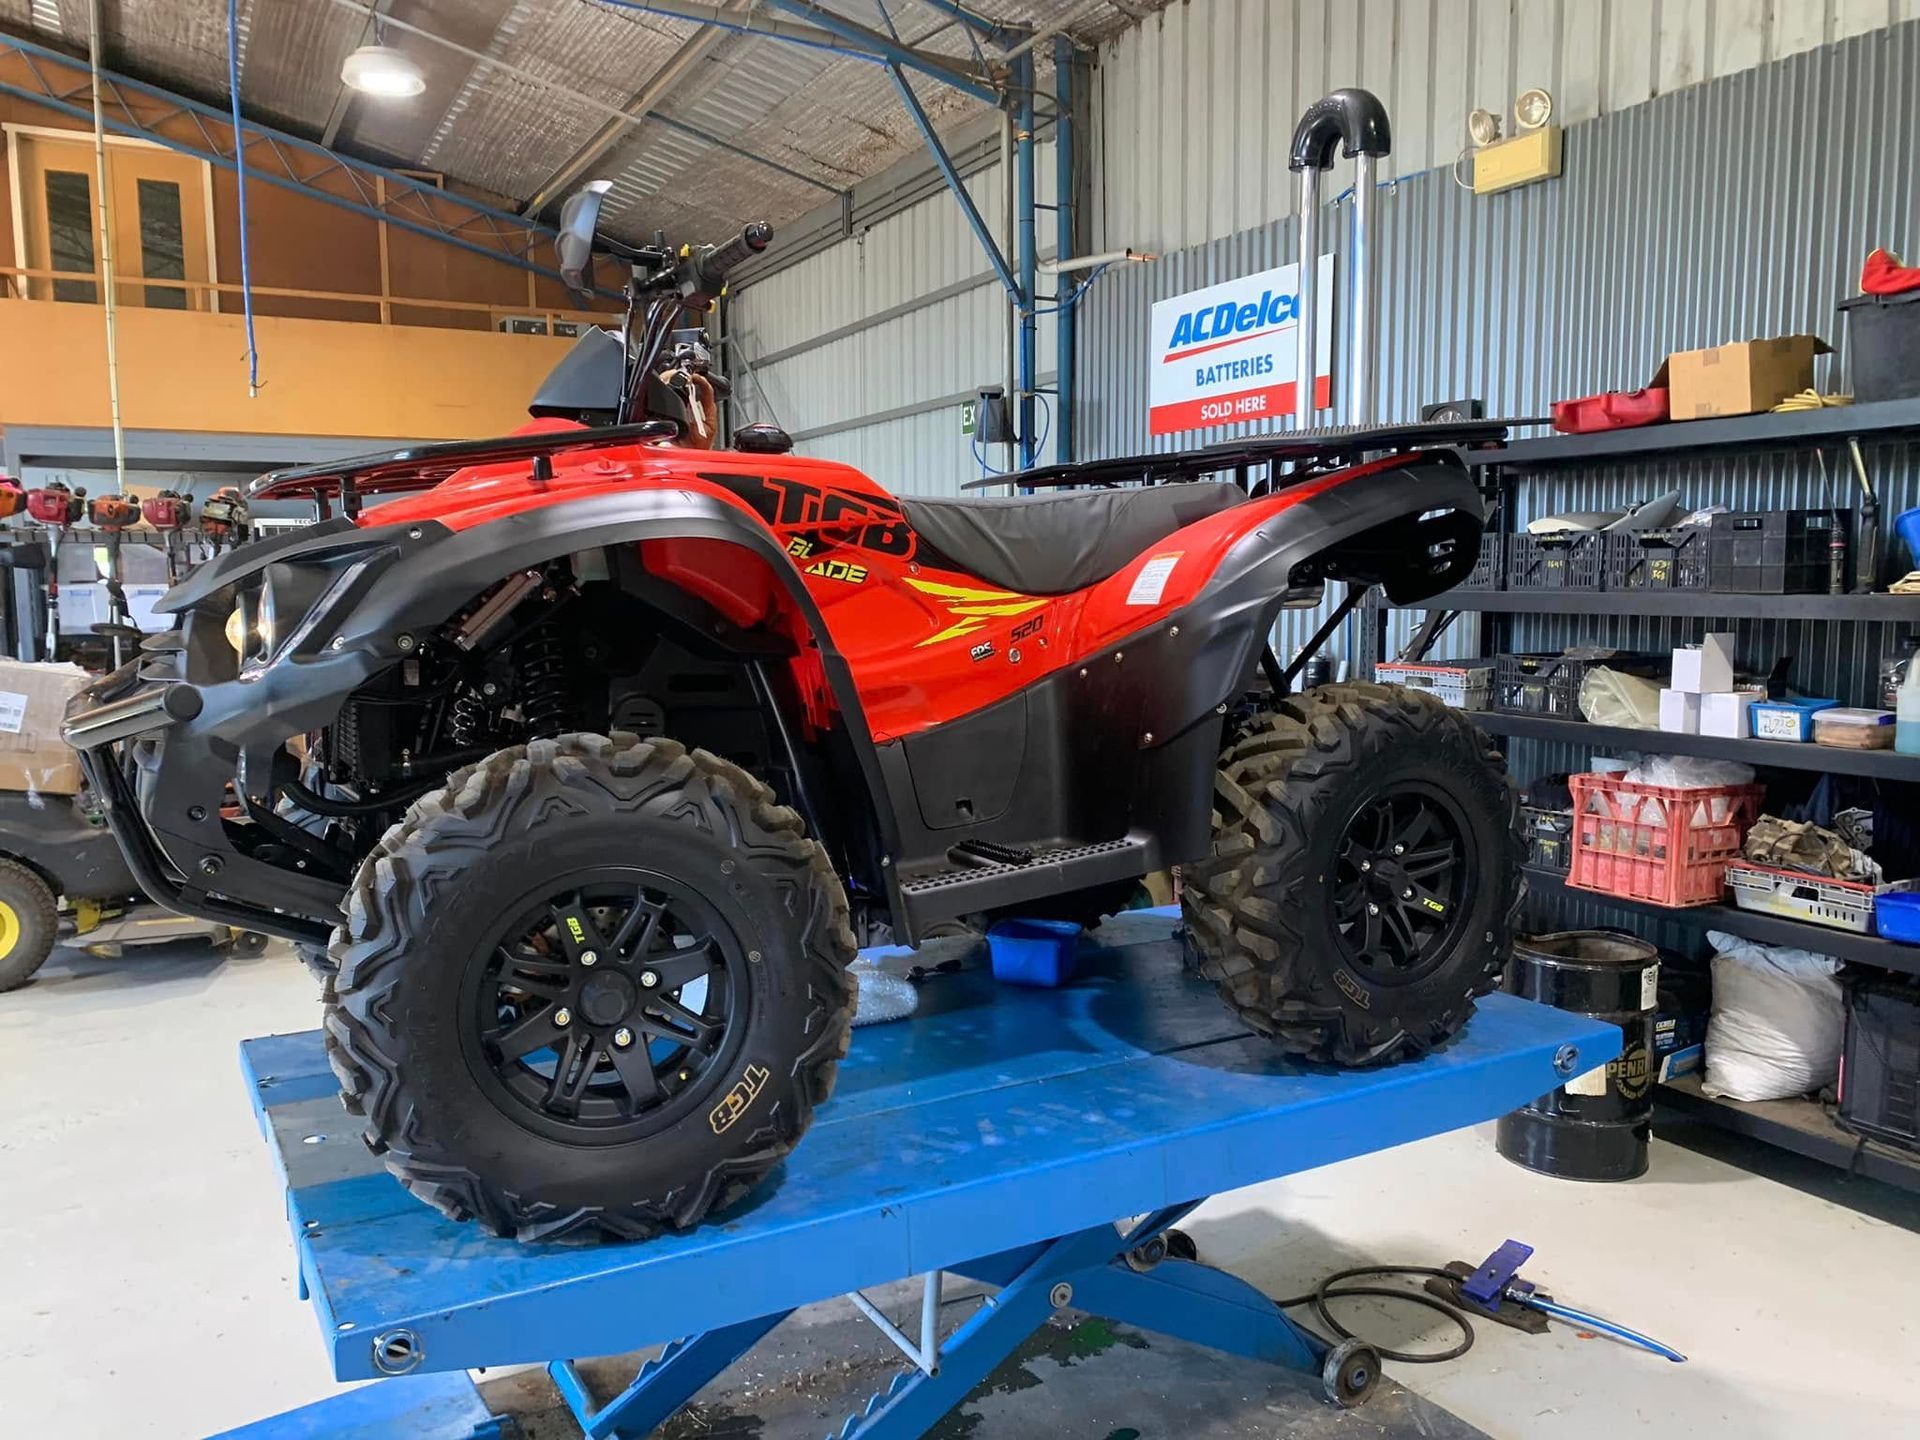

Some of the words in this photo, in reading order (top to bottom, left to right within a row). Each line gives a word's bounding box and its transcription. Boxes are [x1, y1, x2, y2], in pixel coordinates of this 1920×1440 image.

[1195, 353, 1273, 387] BATTERIES
[1201, 401, 1232, 420] SOLD
[1235, 395, 1266, 414] HERE
[1010, 613, 1043, 644] 520
[1423, 897, 1444, 912] TGB
[566, 917, 585, 944] TGB
[1333, 968, 1370, 1009] TGB
[709, 1063, 770, 1134] TGB
